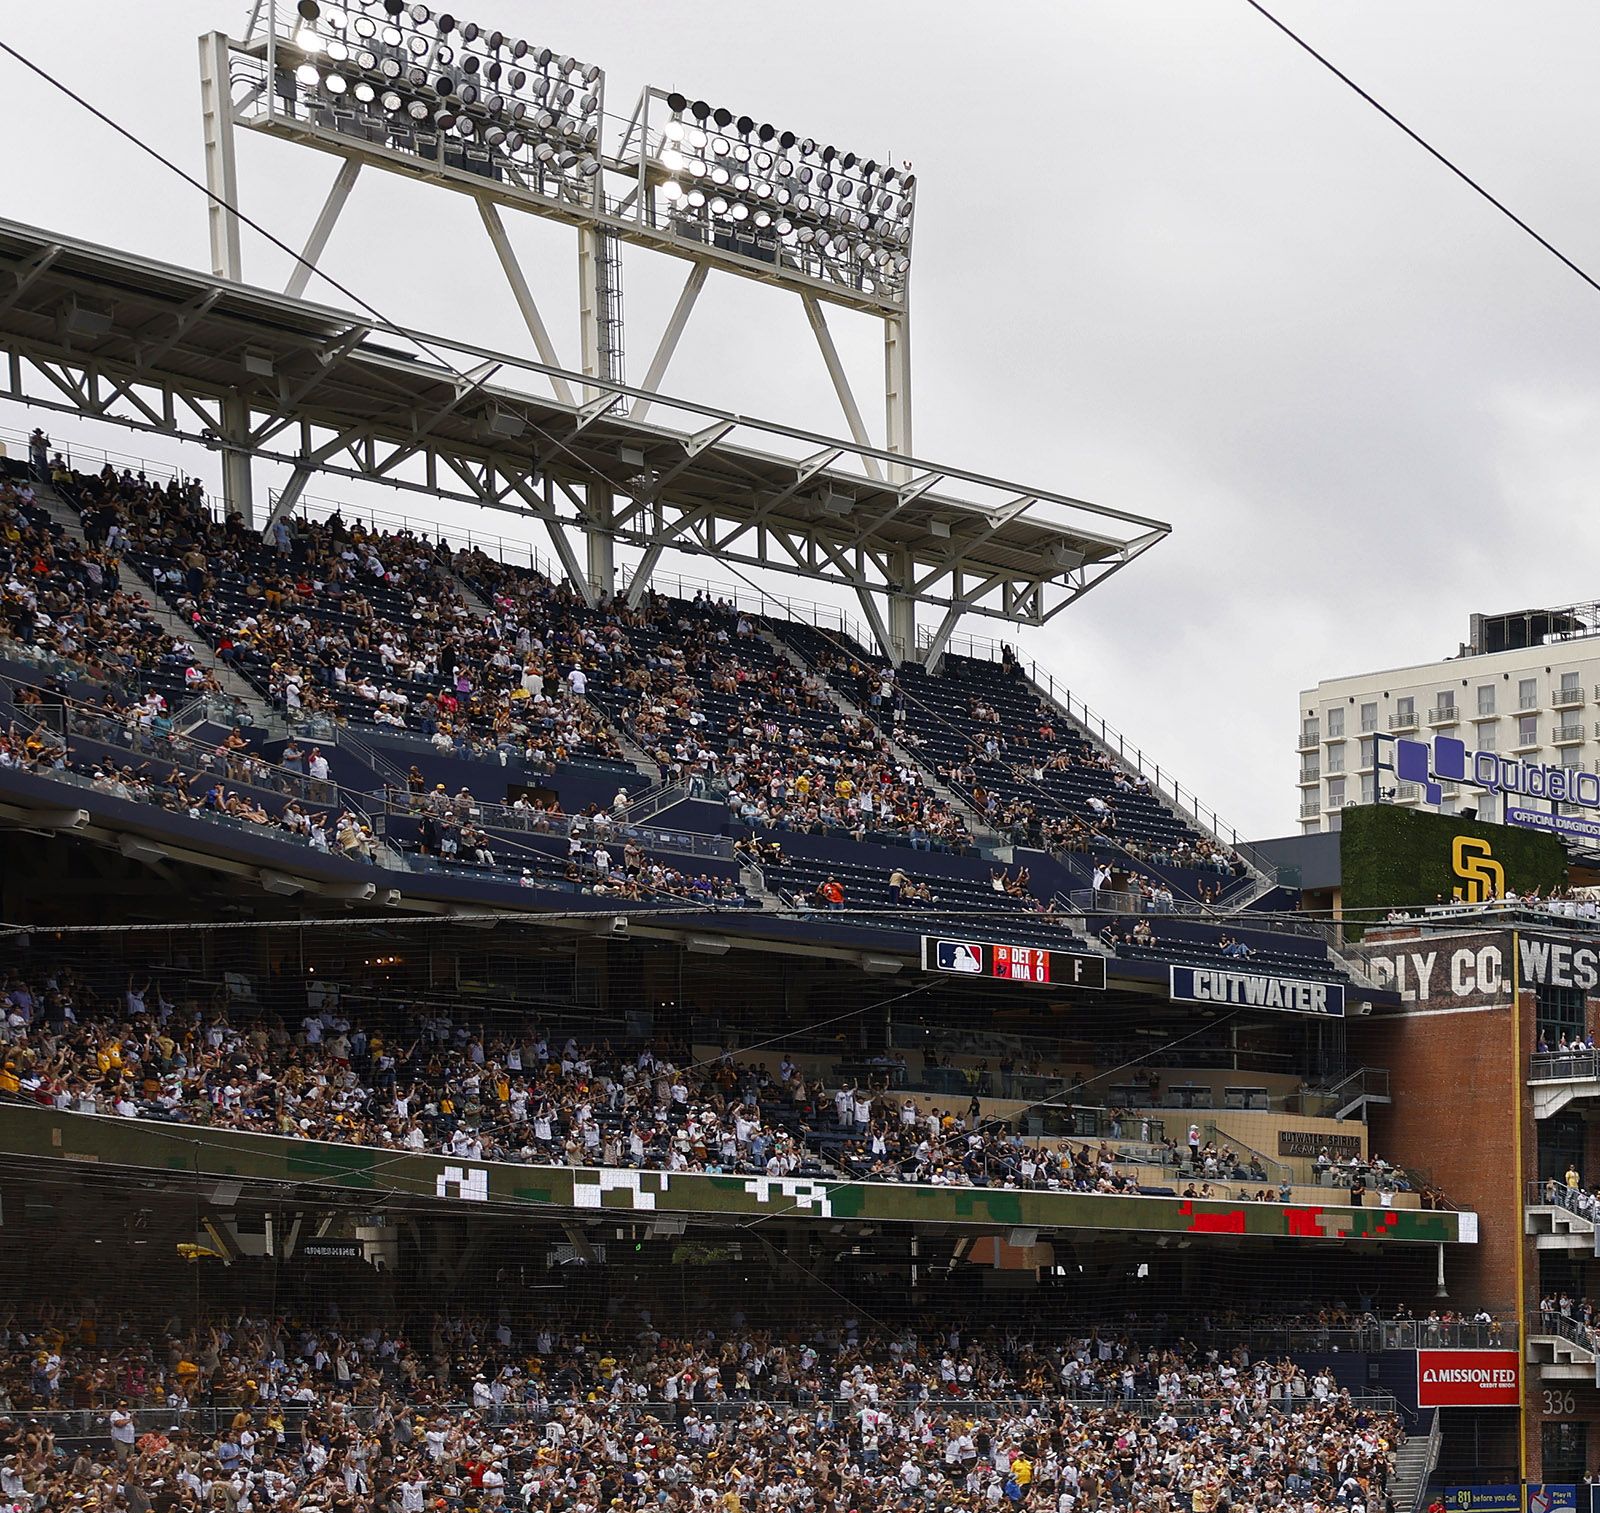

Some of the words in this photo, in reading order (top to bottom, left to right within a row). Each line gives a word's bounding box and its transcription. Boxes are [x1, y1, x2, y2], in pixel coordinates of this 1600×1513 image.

[1513, 810, 1556, 828] OFFICIAL
[1012, 948, 1030, 964] DET
[1036, 951, 1044, 966] 2
[1012, 964, 1031, 980] MIA
[1037, 967, 1044, 982] 0
[1074, 959, 1083, 982] F
[1193, 970, 1328, 1013] CUTWATER
[1328, 1135, 1360, 1147] SPIRITS
[1439, 1368, 1492, 1383] MISSION
[1493, 1368, 1516, 1383] FED
[1542, 1389, 1576, 1415] 336
[1457, 1490, 1471, 1503] 811
[1473, 1494, 1494, 1502] before
[1494, 1495, 1506, 1503] you
[1552, 1491, 1565, 1499] Play
